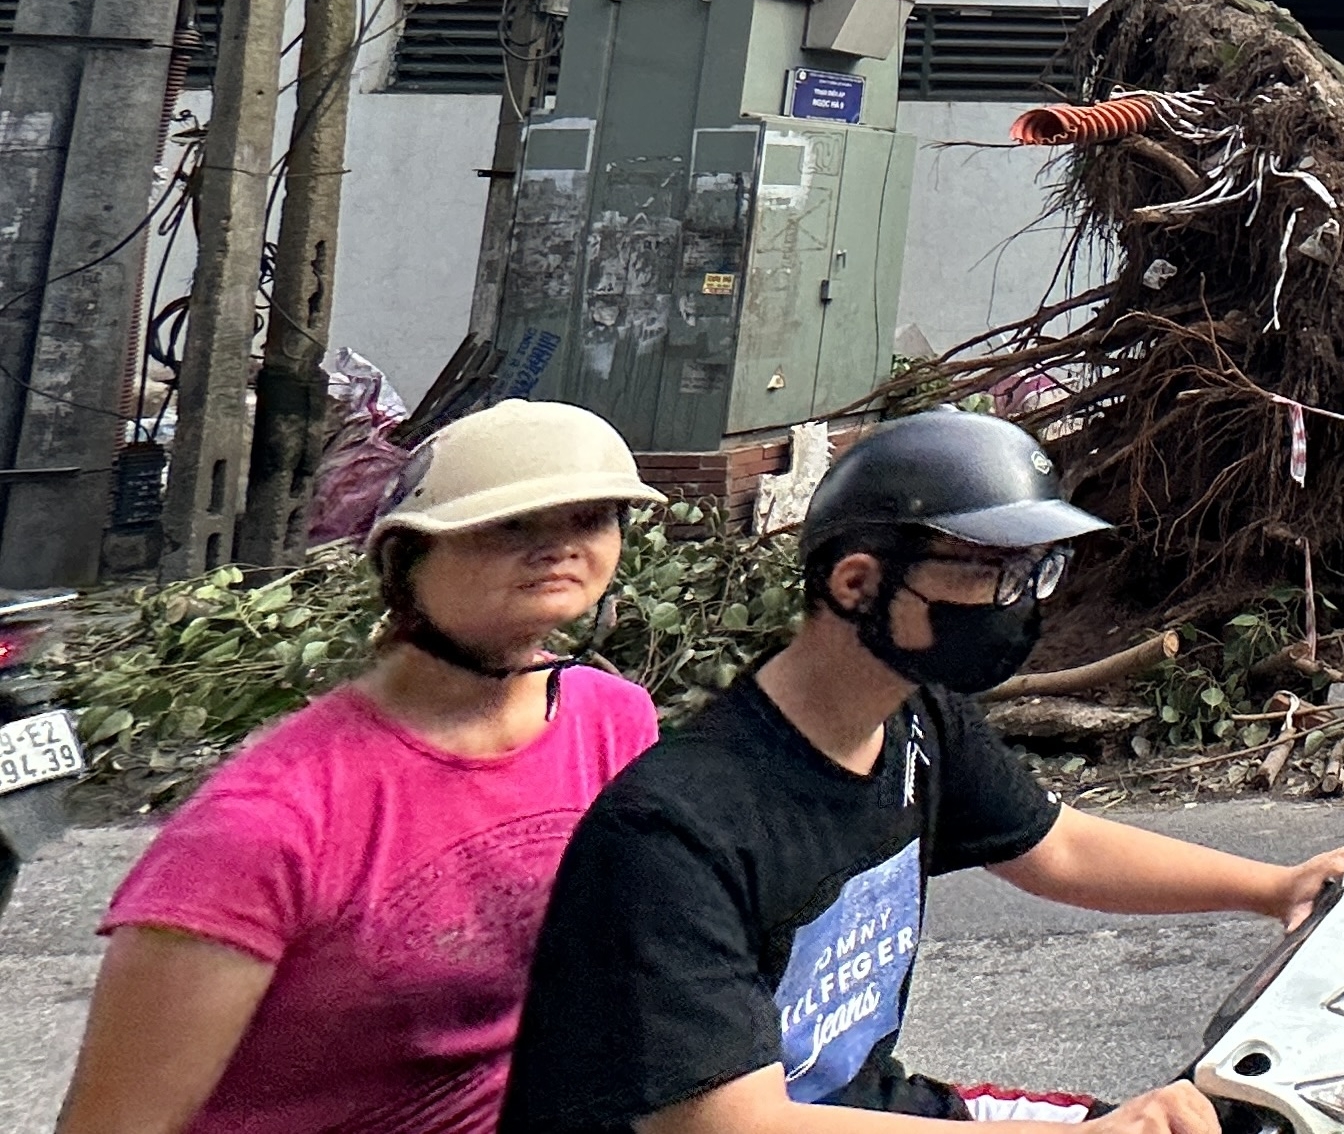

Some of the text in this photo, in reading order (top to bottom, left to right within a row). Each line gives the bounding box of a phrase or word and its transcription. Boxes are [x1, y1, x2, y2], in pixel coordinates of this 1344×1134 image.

[0, 720, 62, 756] 9-E2
[0, 744, 76, 784] 94.39
[785, 982, 880, 1081] jeans
